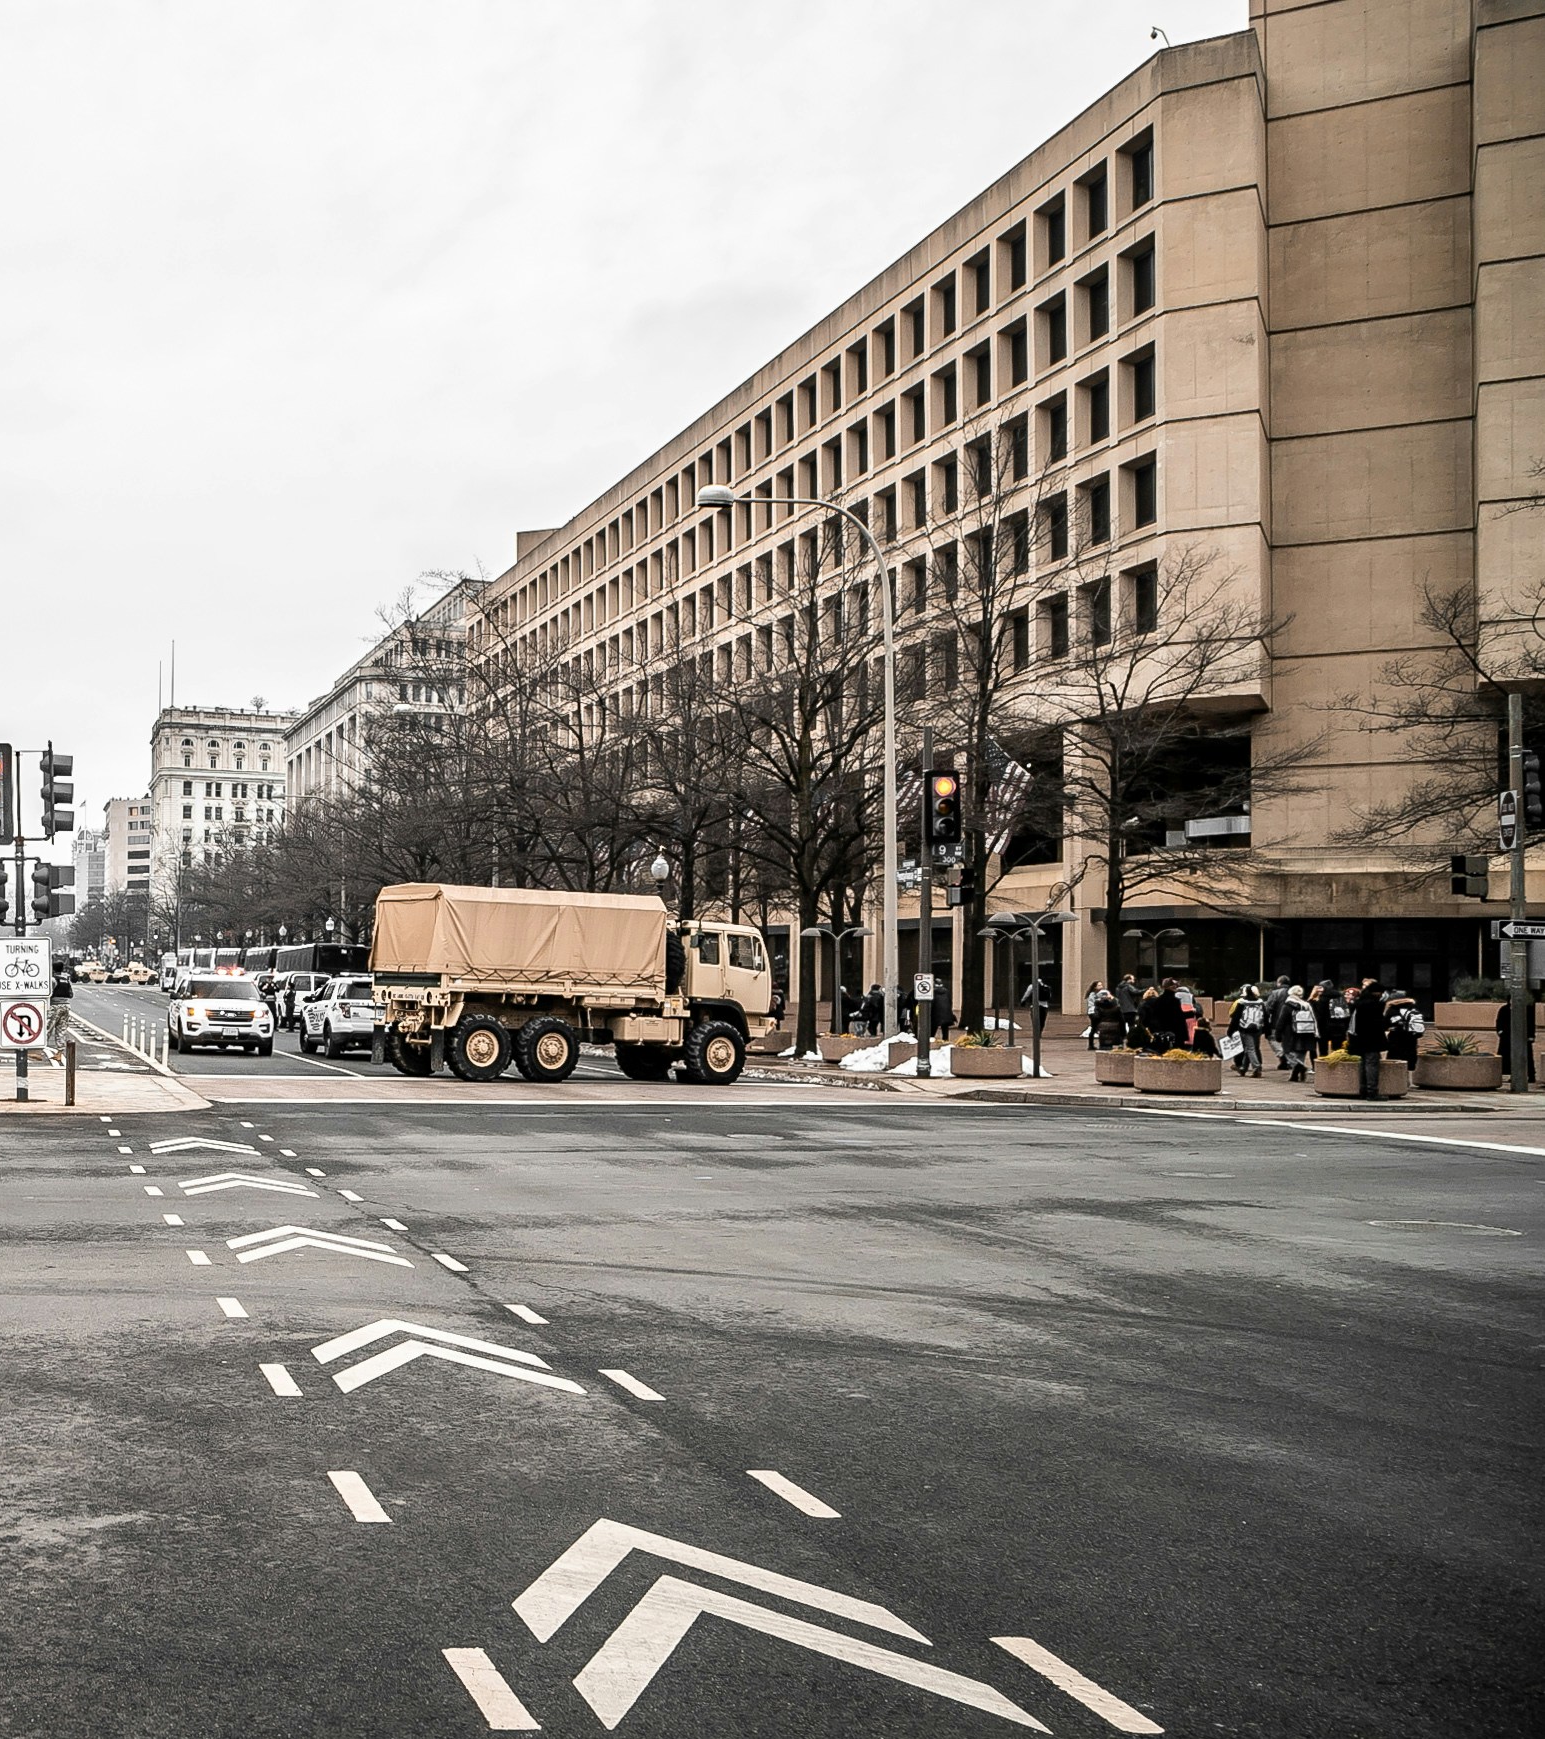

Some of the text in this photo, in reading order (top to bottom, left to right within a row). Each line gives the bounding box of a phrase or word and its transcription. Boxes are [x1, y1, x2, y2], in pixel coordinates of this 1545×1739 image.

[939, 844, 947, 855] 9
[1514, 926, 1529, 934] ONE
[5, 944, 39, 954] TURNING
[15, 980, 49, 990] X-WALKS
